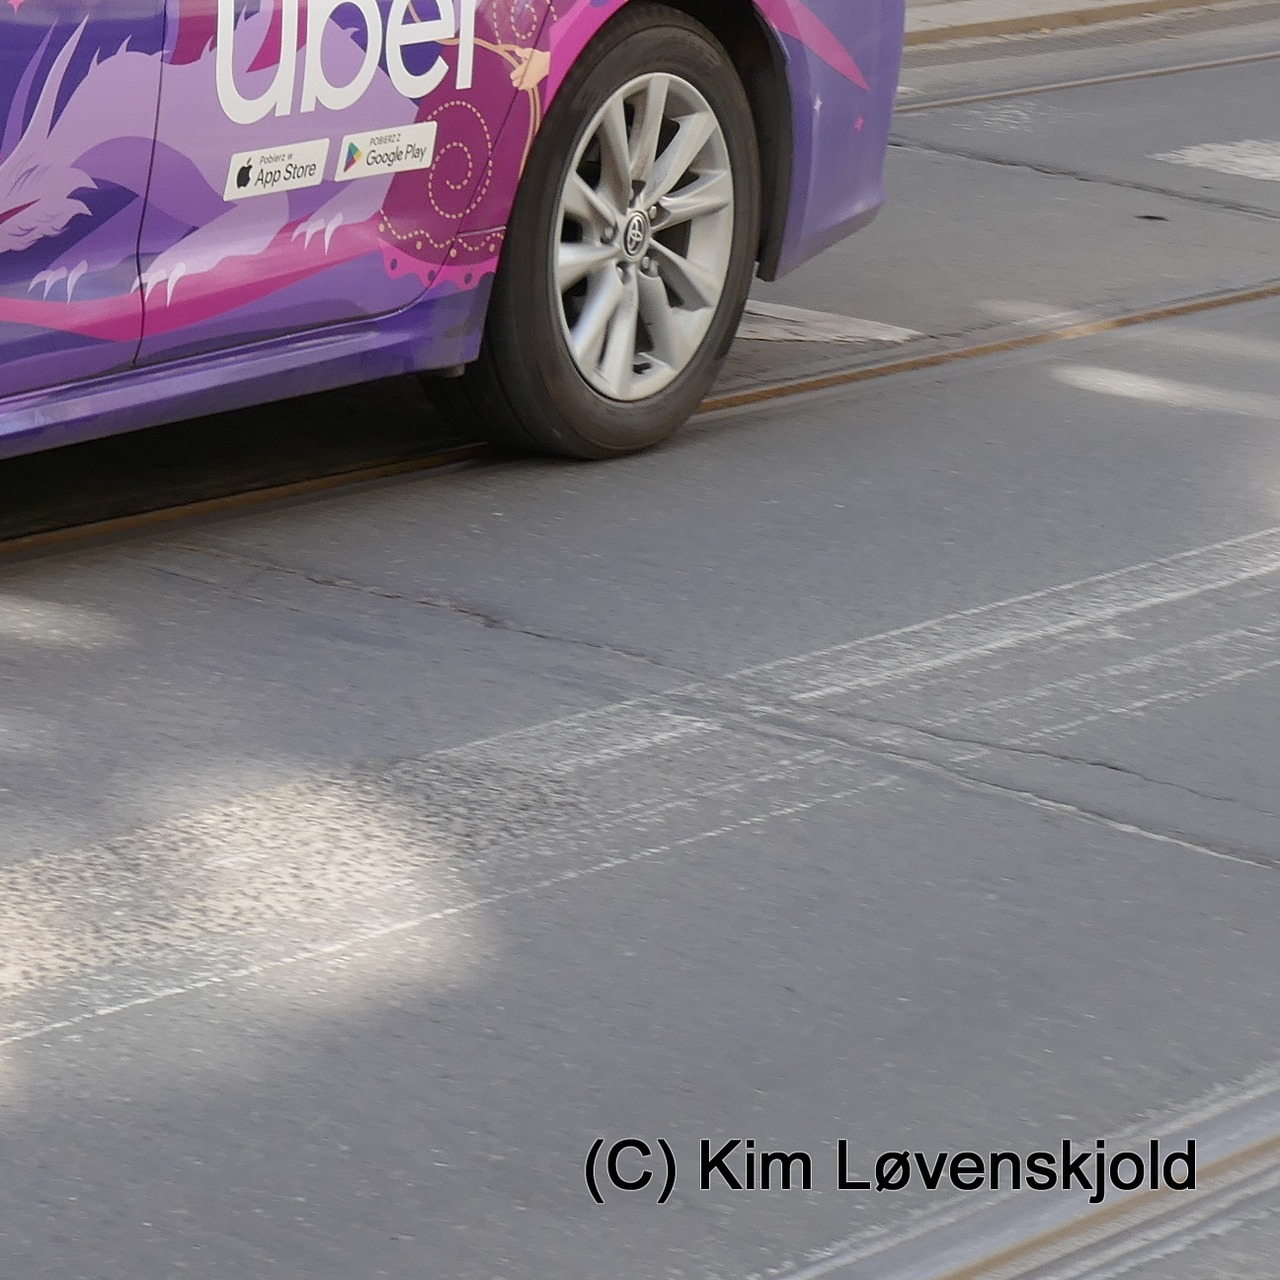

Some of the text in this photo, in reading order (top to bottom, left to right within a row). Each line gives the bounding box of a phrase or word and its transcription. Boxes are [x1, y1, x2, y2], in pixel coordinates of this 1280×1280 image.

[259, 153, 287, 166] Pobierz
[365, 143, 428, 167] Google Play
[254, 162, 317, 189] App Store
